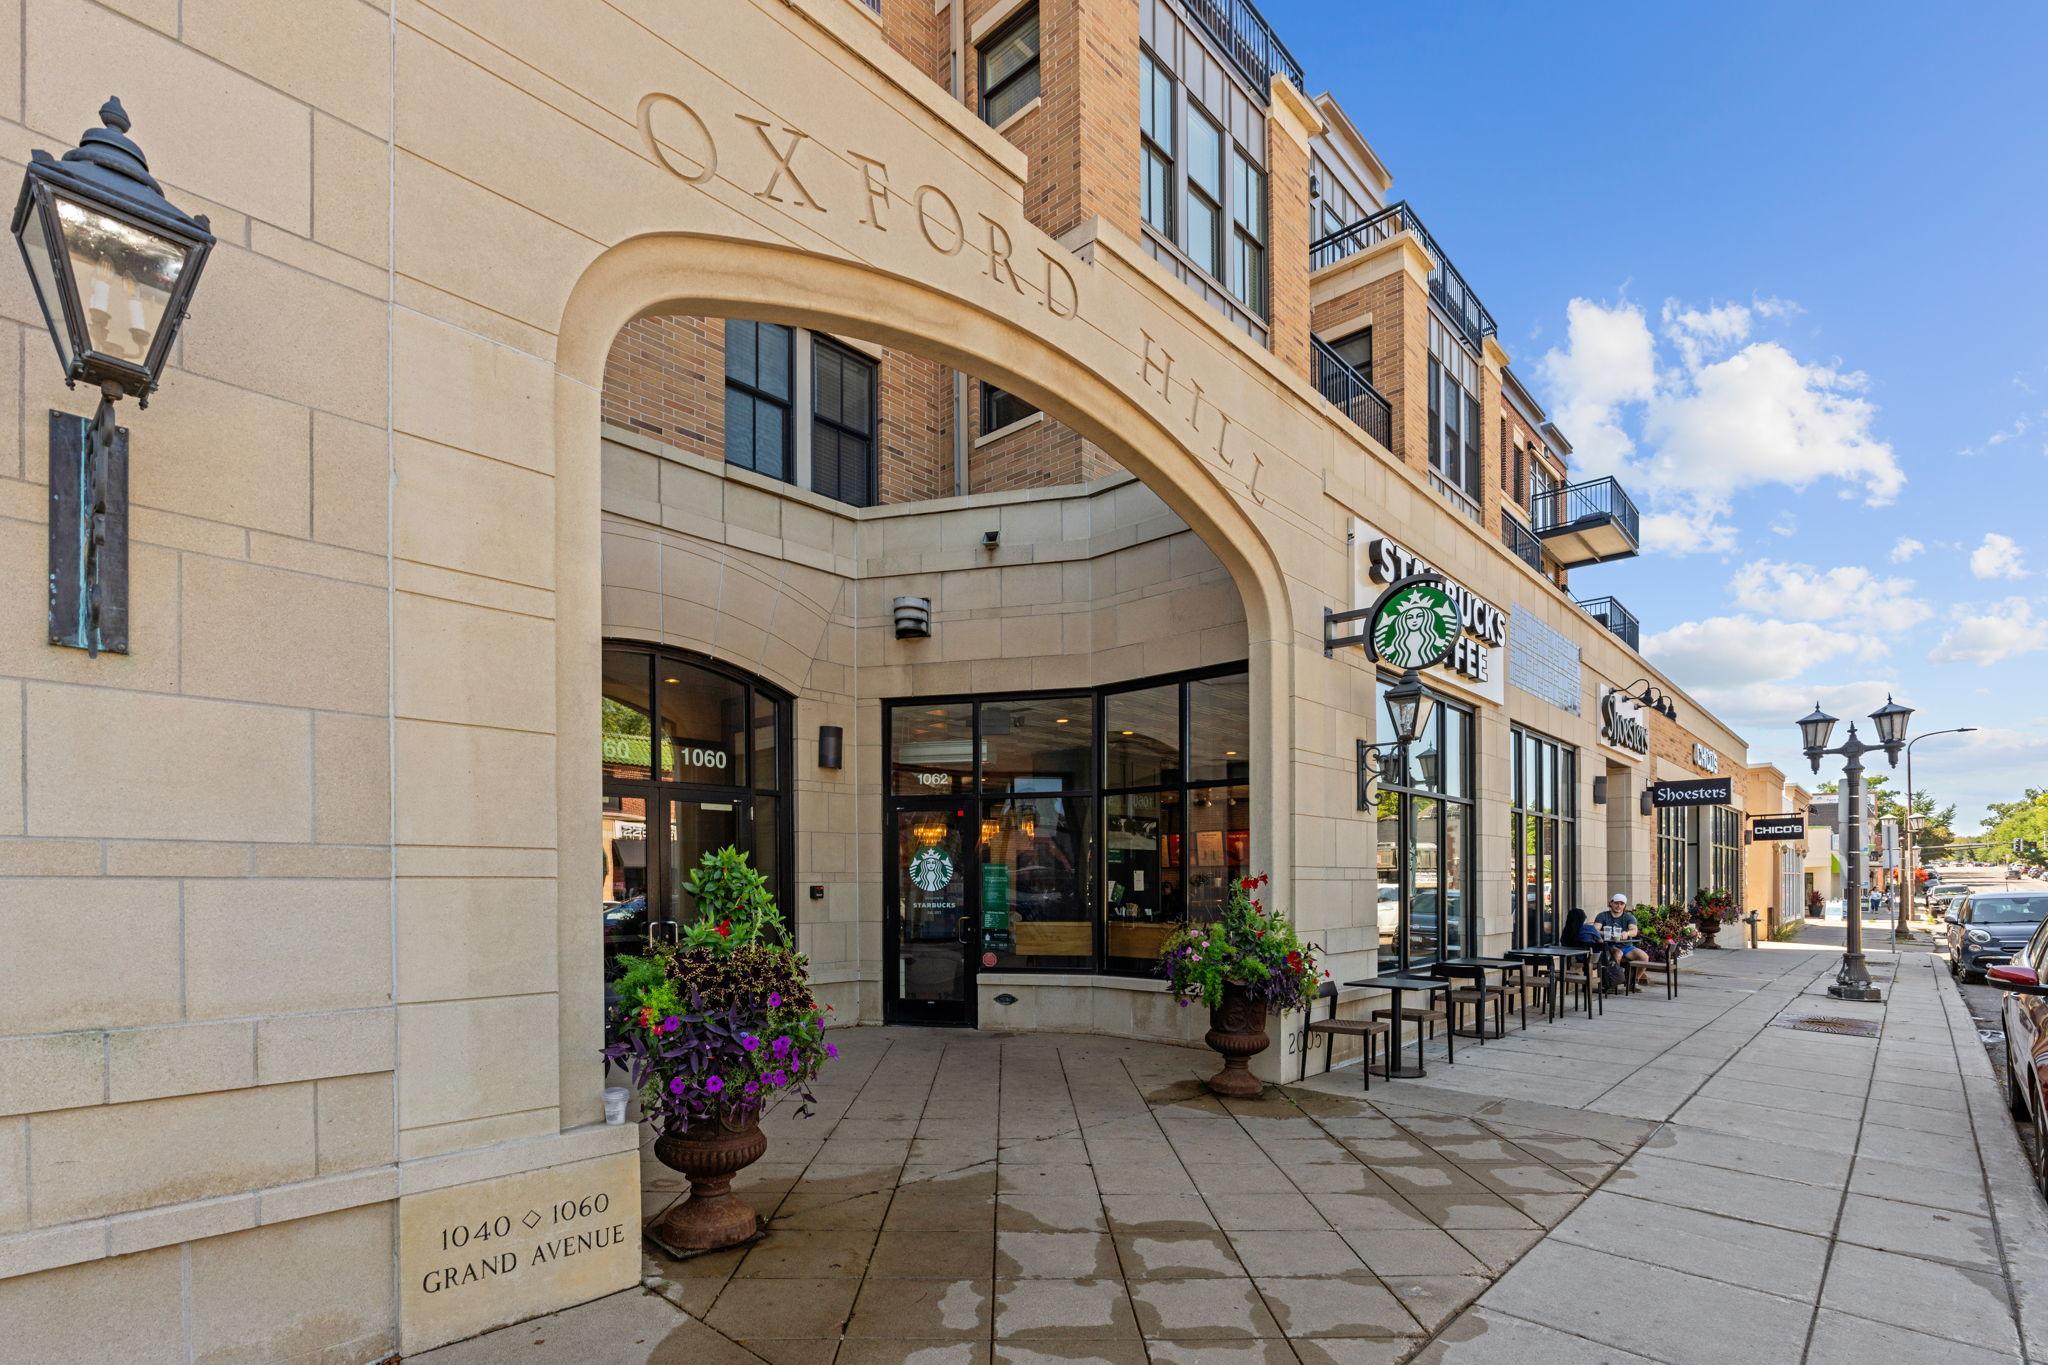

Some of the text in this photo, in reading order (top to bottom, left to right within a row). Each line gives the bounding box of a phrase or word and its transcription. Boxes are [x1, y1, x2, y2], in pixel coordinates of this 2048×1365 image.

[637, 92, 1267, 505] OXFORD HILL
[681, 748, 727, 769] 1060
[917, 772, 948, 785] 1062
[1657, 787, 1727, 802] Shoesters
[1754, 824, 1803, 834] CHICO'S
[441, 1192, 609, 1250] 1040 1060
[422, 1223, 625, 1293] GRAND AVENUE
